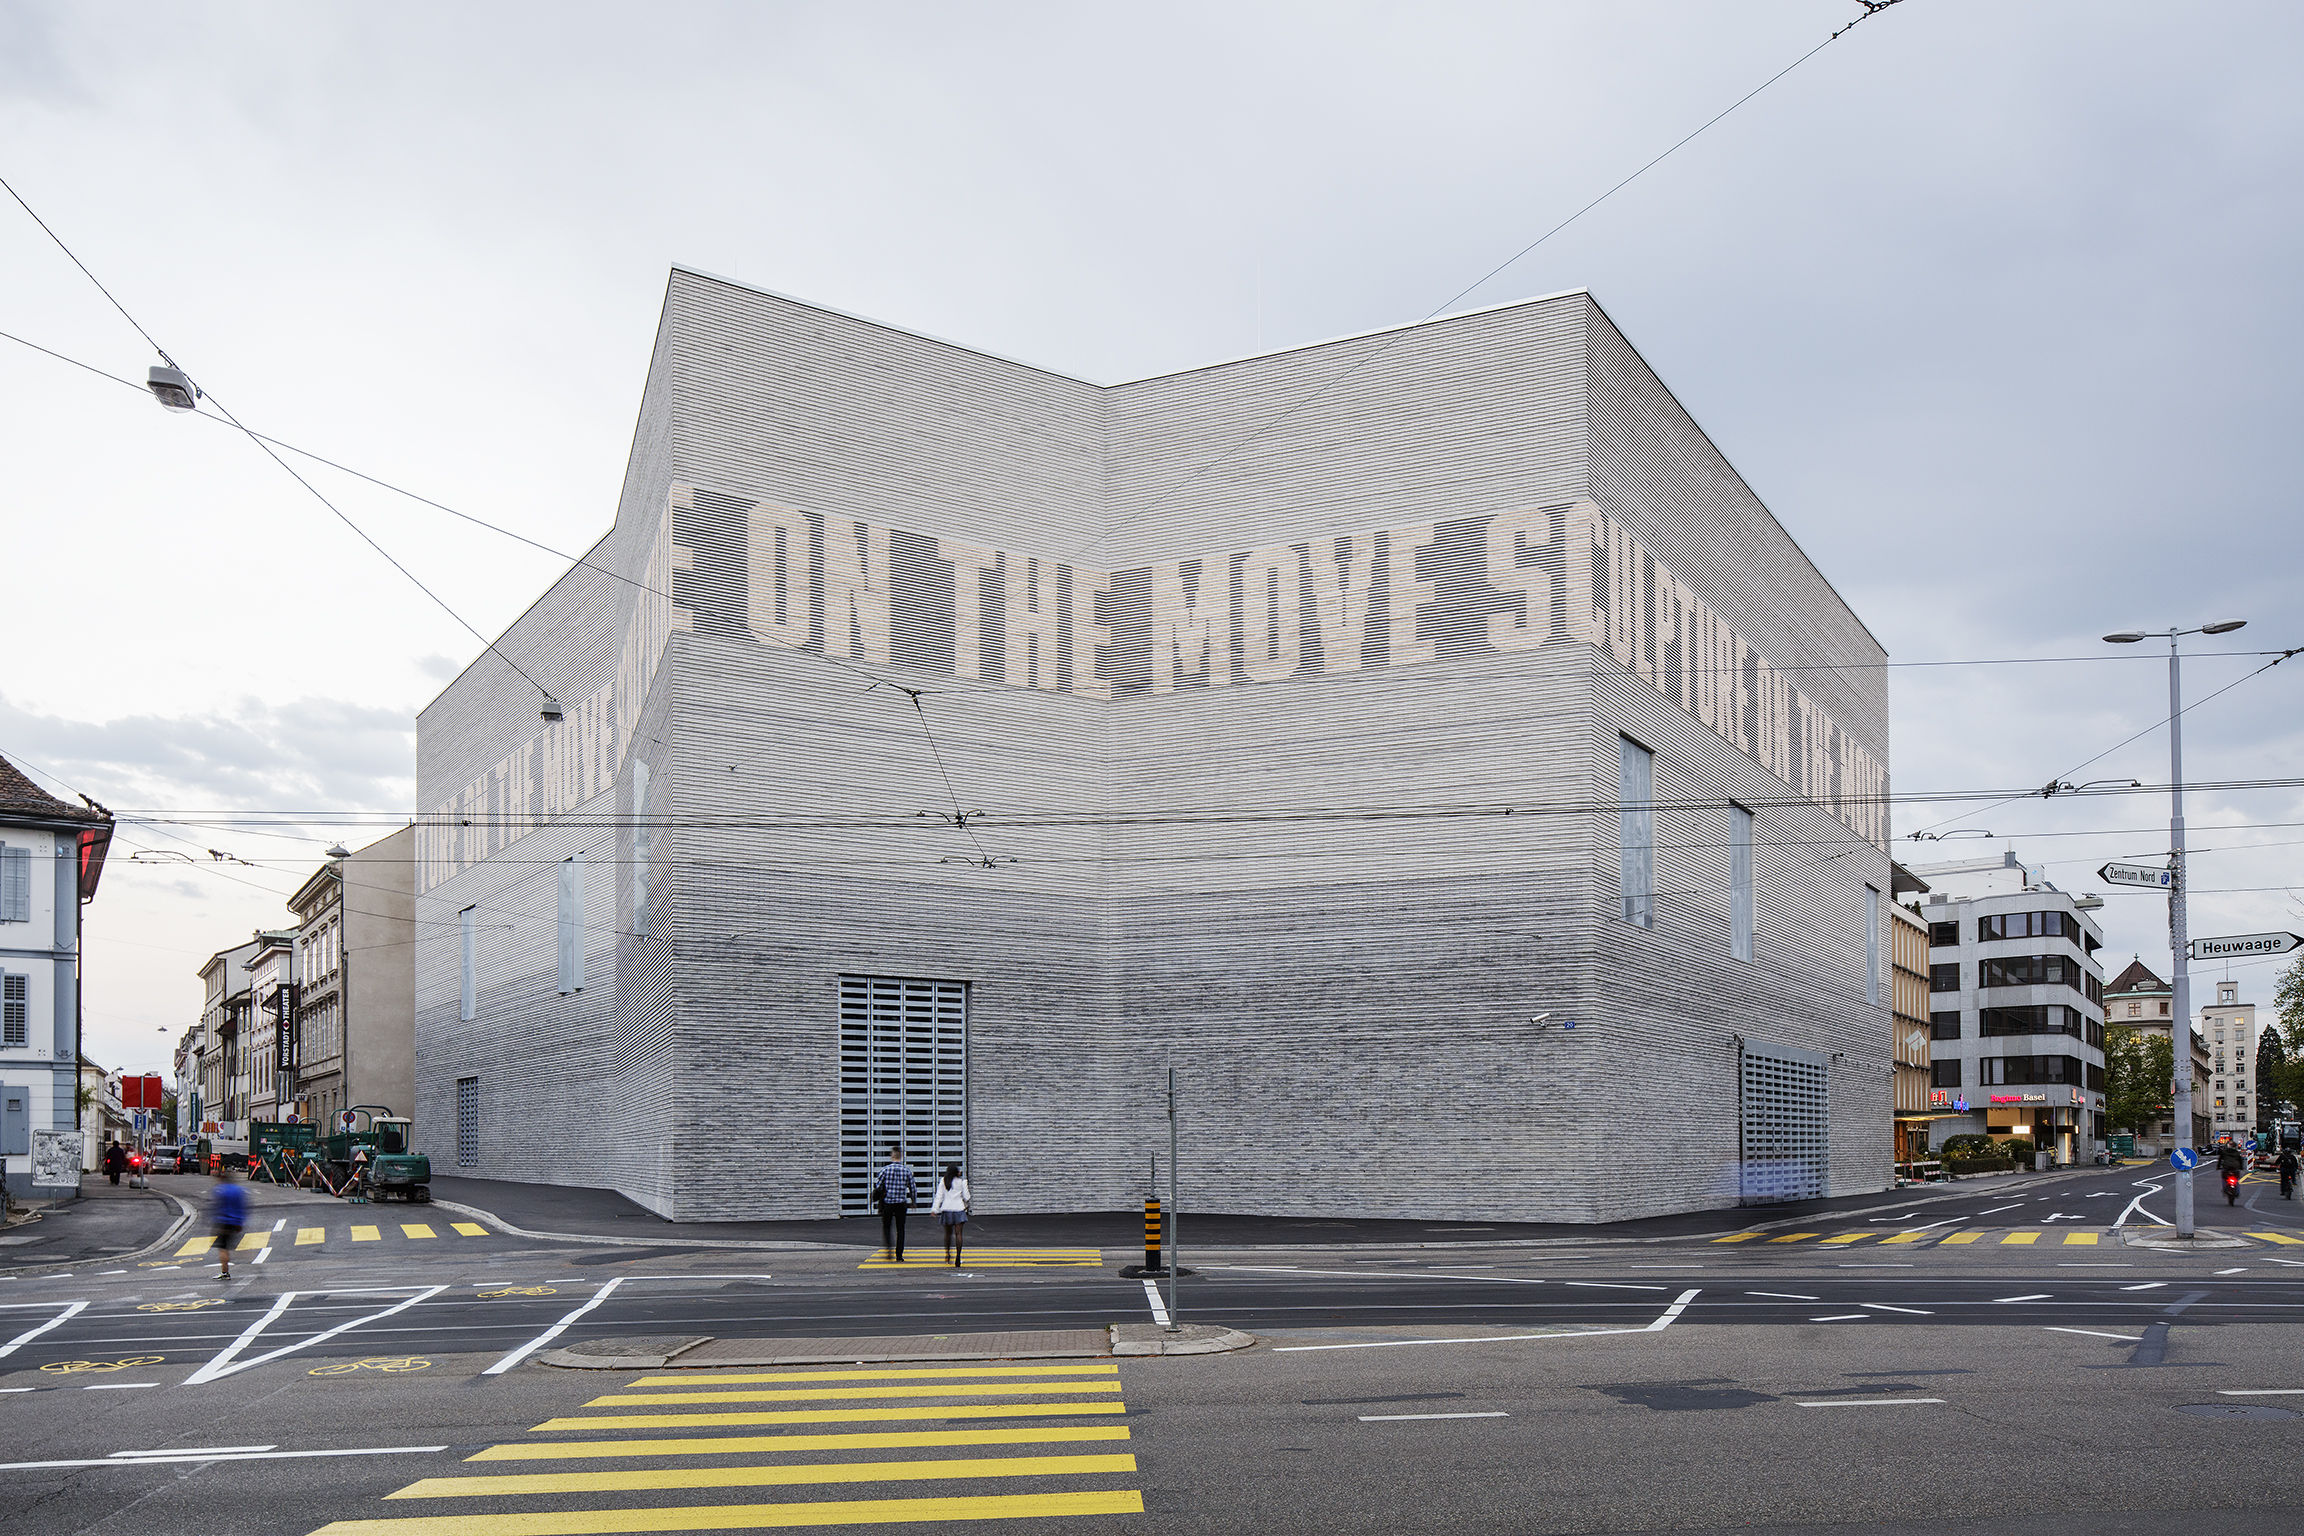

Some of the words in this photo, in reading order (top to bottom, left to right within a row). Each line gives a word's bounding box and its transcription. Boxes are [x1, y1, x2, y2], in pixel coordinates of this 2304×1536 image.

[415, 793, 457, 895] TURE
[464, 772, 488, 870] ON
[495, 739, 534, 850] THE
[543, 681, 613, 825] MOVE
[747, 500, 890, 664] ON
[937, 538, 1111, 701] THE
[1152, 523, 1436, 695] MOVE
[1486, 499, 1750, 756] SCULPTURE
[1756, 654, 1790, 785] ON
[1797, 690, 1835, 816] THE
[1839, 728, 1885, 852] MOVE
[2109, 866, 2138, 881] Zentrum
[2140, 870, 2156, 883] Nord
[2203, 939, 2281, 954] Heuwaage
[281, 988, 290, 1020] THEATER
[281, 1030, 290, 1067] VORSTADT
[2023, 1093, 2046, 1102] Basel
